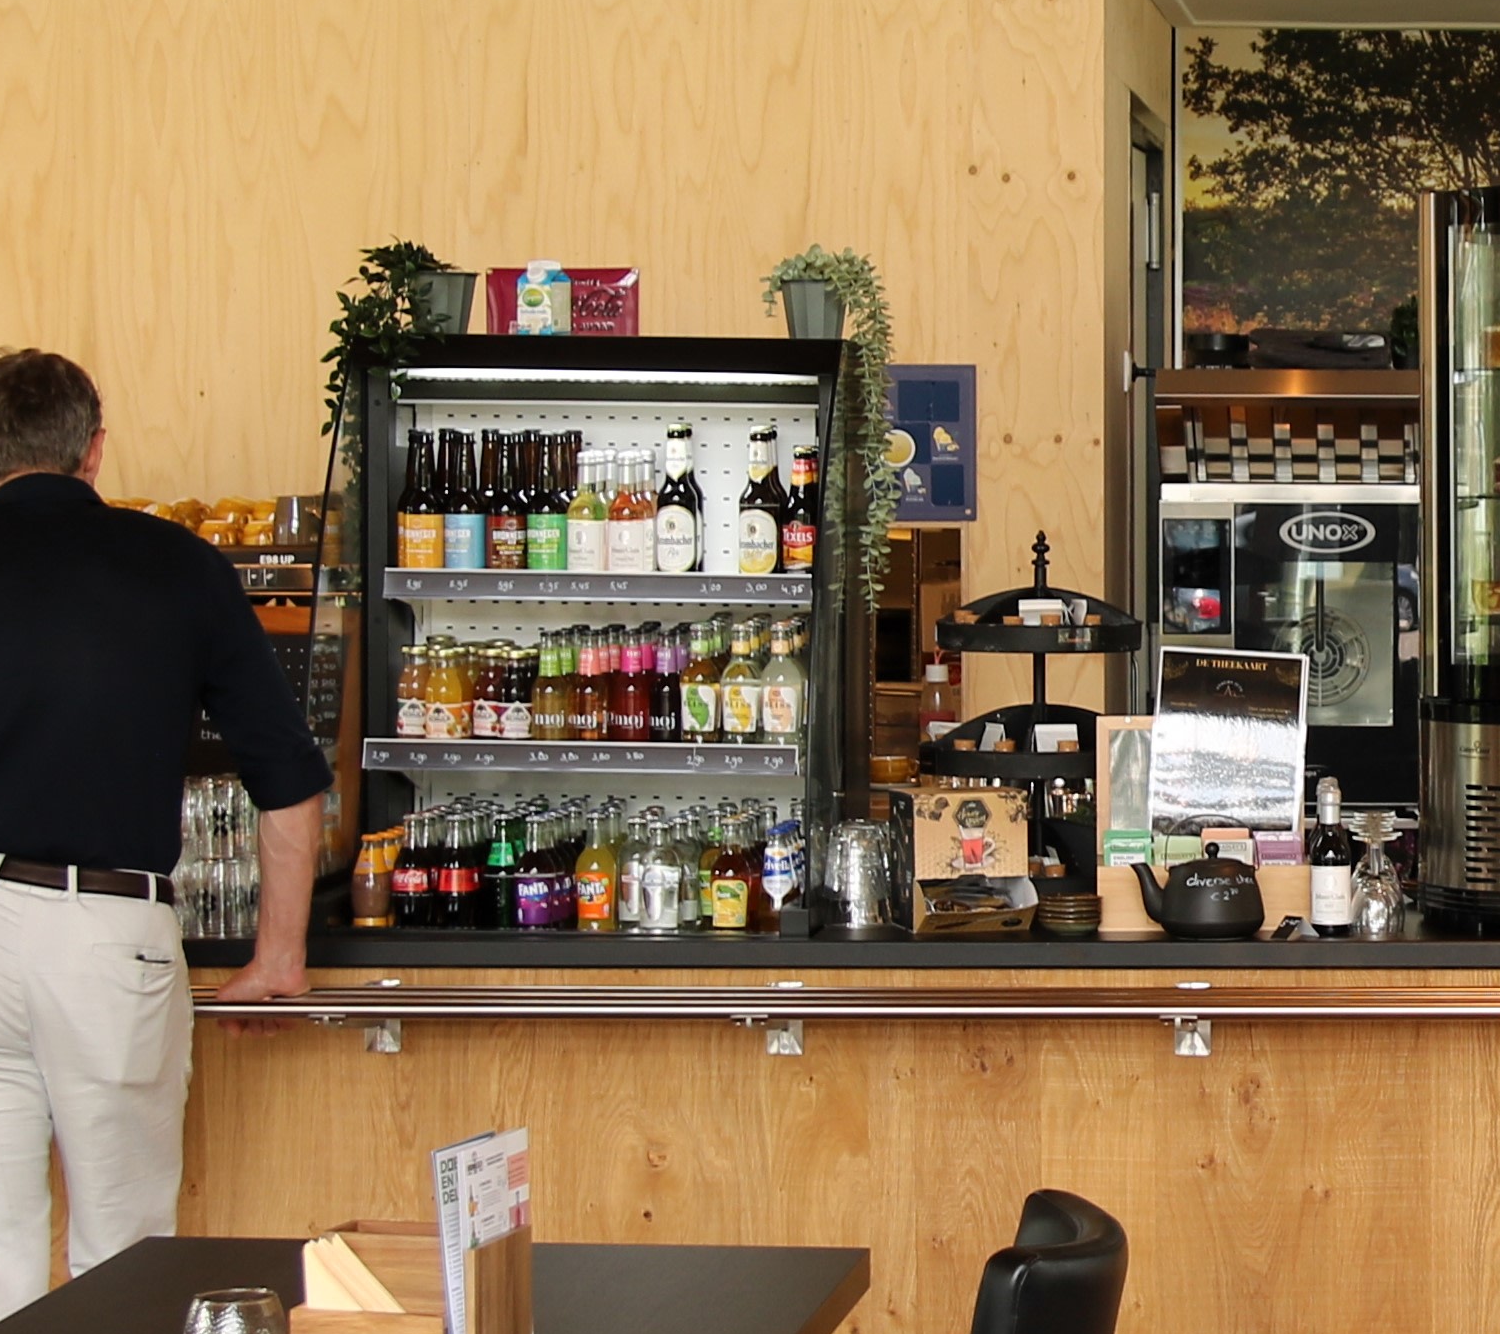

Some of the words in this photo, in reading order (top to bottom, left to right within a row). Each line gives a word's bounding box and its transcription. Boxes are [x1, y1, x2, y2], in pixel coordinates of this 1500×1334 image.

[783, 527, 813, 543] TEXELS
[1291, 524, 1359, 541] UNOX
[280, 554, 295, 564] UP
[1196, 658, 1207, 667] DE
[534, 710, 565, 728] moj
[1186, 872, 1231, 887] diverse
[518, 881, 549, 896] FANTA
[577, 882, 606, 897] FANTA
